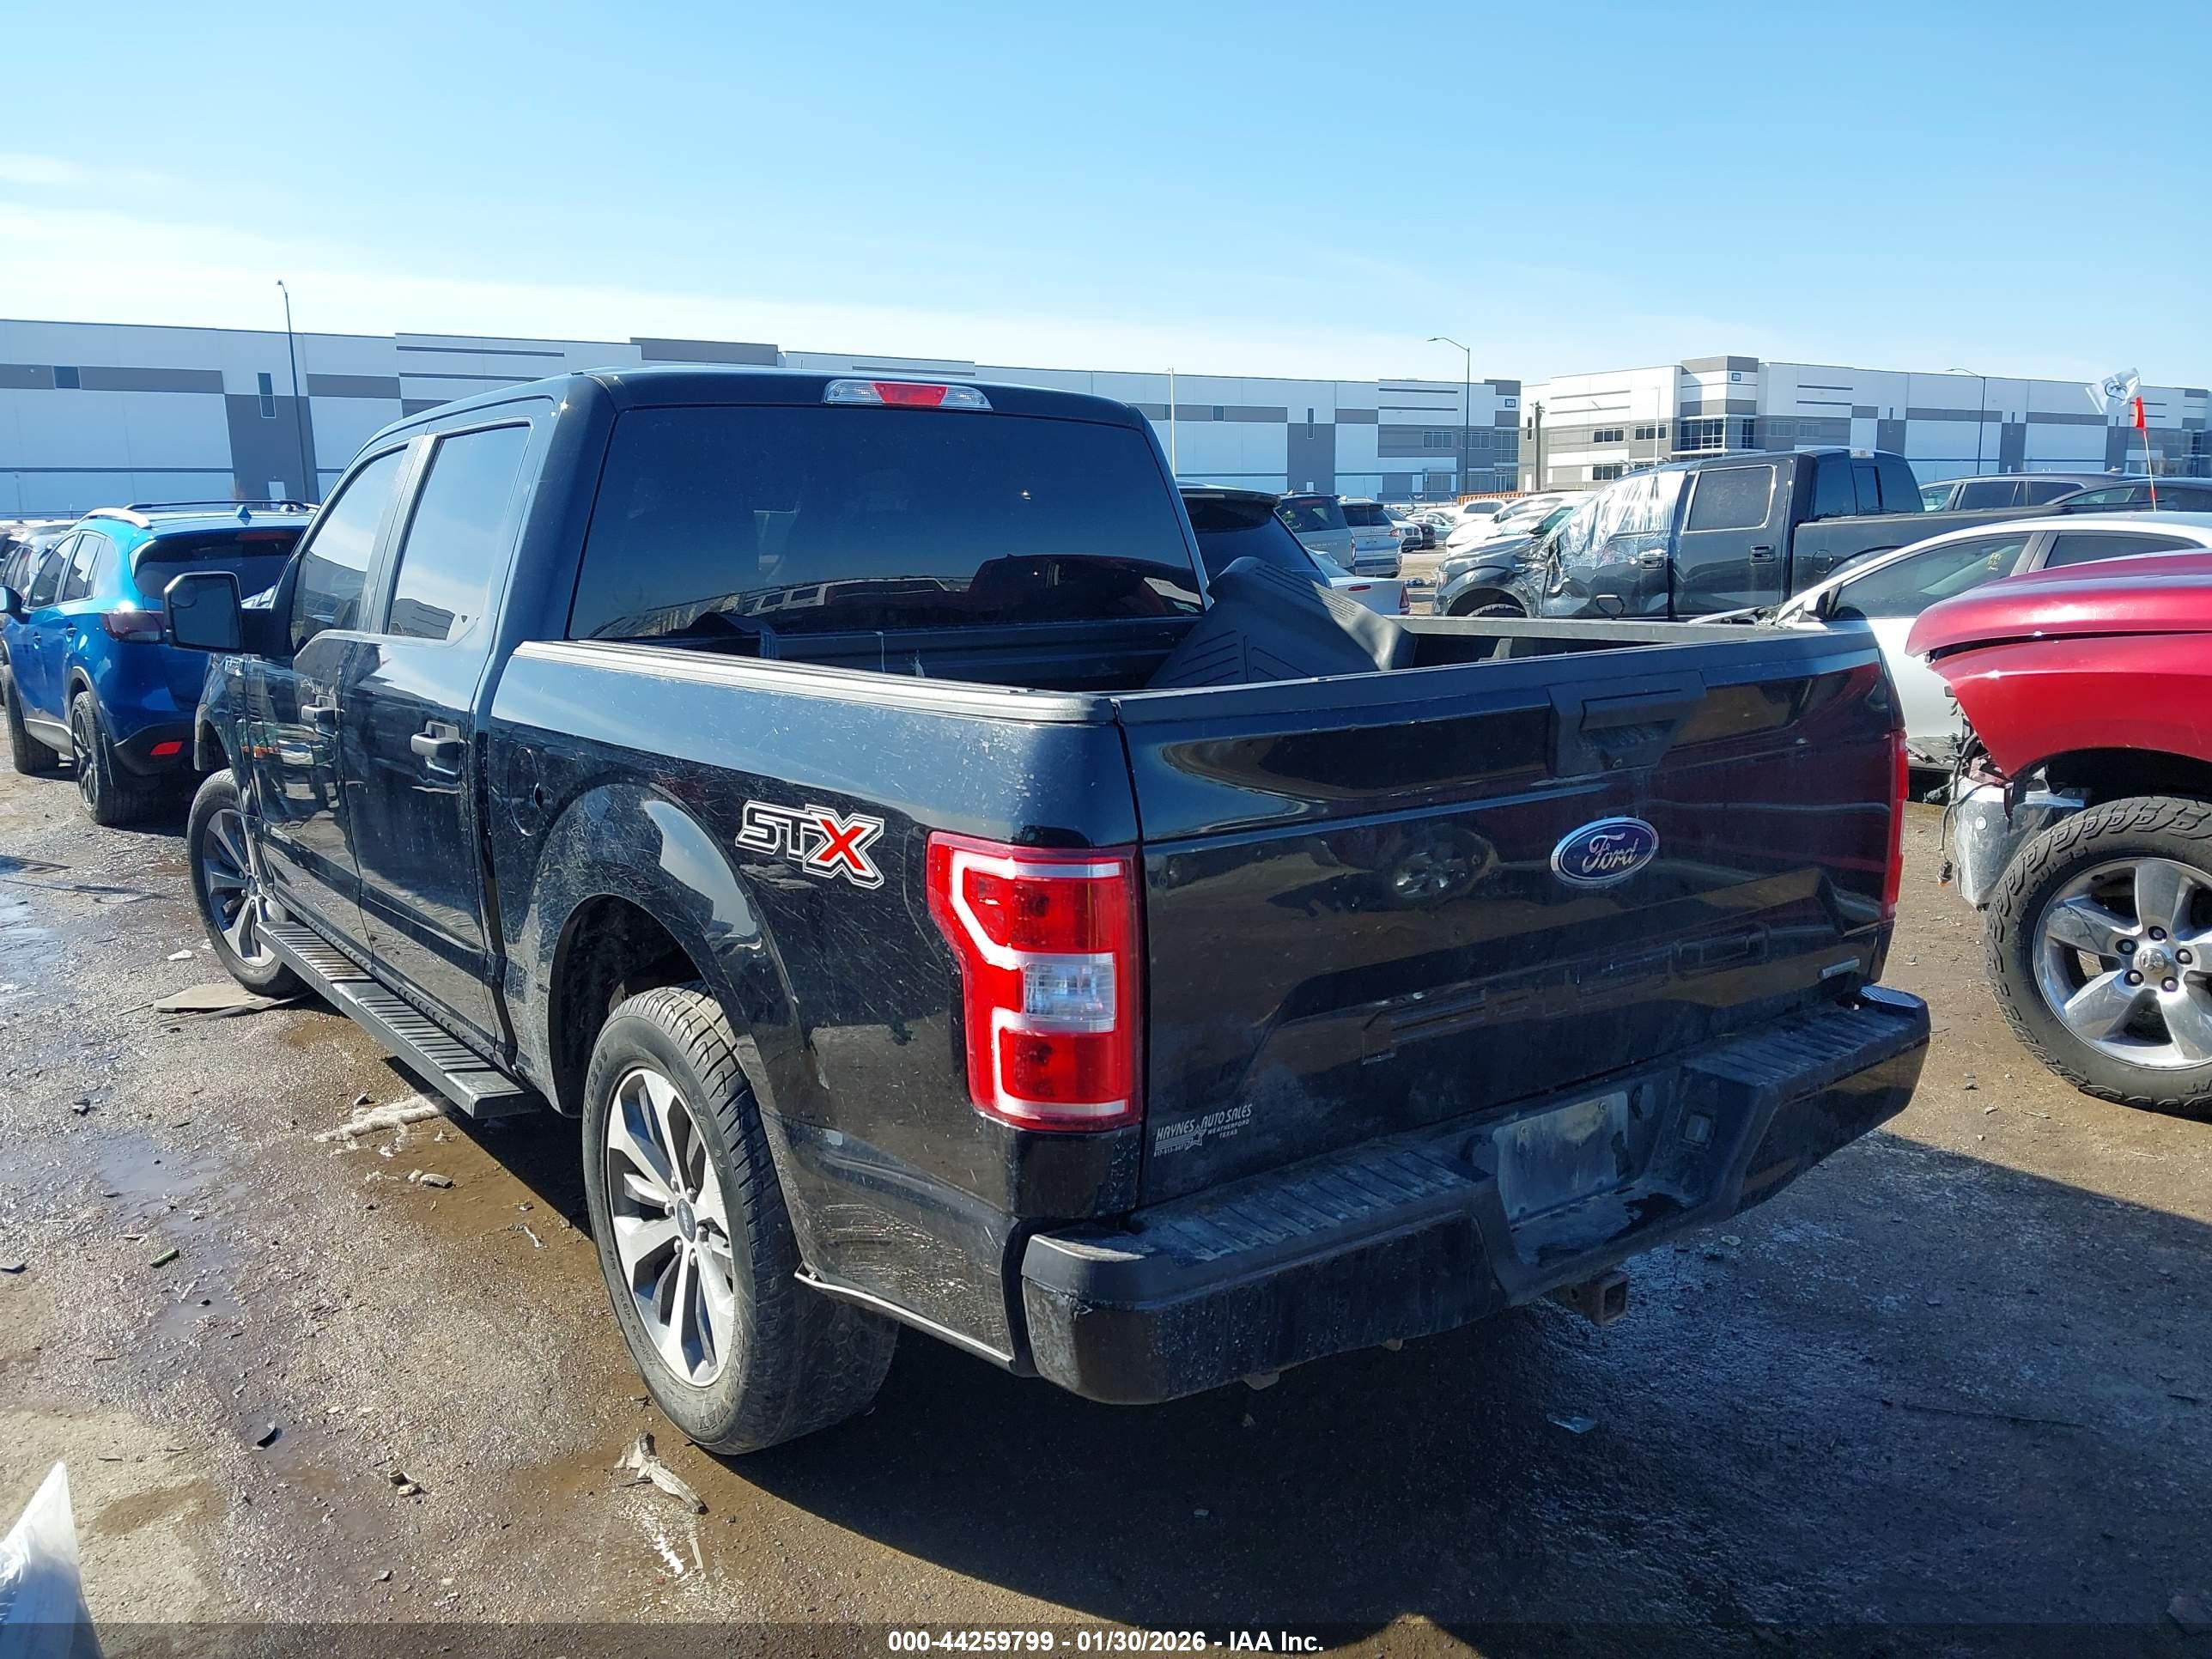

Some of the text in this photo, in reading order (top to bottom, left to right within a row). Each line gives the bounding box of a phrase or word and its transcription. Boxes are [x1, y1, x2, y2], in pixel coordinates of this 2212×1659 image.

[735, 799, 884, 890] STX
[1582, 832, 1639, 873] Ford
[1156, 1104, 1253, 1141] HAYNES AUTO SALES
[1207, 1118, 1251, 1136] WEATHERFORD
[1218, 1129, 1238, 1139] TEXAS
